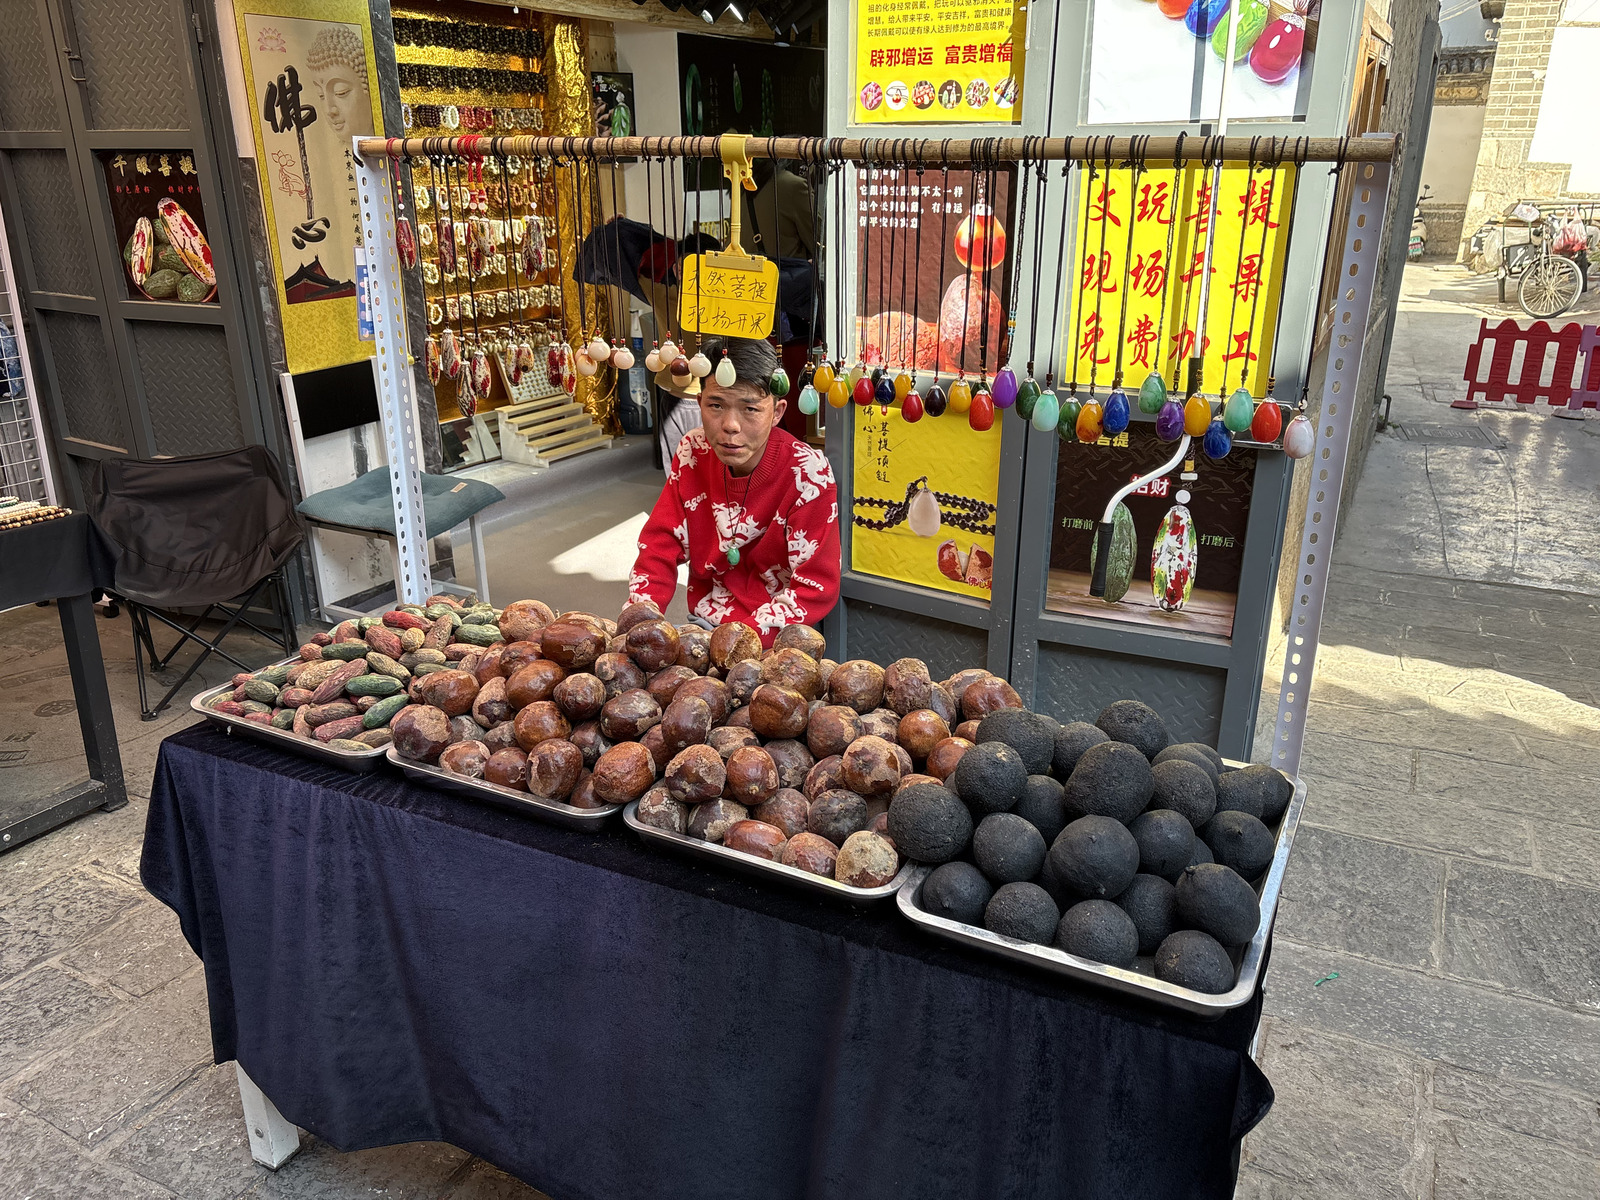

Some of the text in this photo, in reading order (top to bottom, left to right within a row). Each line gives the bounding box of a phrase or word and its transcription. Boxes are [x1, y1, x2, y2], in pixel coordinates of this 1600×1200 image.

[945, 42, 1014, 65] 富贵增福
[113, 154, 198, 177] 千眼菩提
[1088, 179, 1281, 234] 文玩菩提
[688, 269, 768, 301] 天然菩提
[1083, 249, 1265, 303] 现场开果
[687, 305, 767, 336] 现场开果
[1080, 310, 1258, 369] 免费加工
[1061, 516, 1095, 531] 打磨前
[1200, 534, 1235, 548] 打磨后
